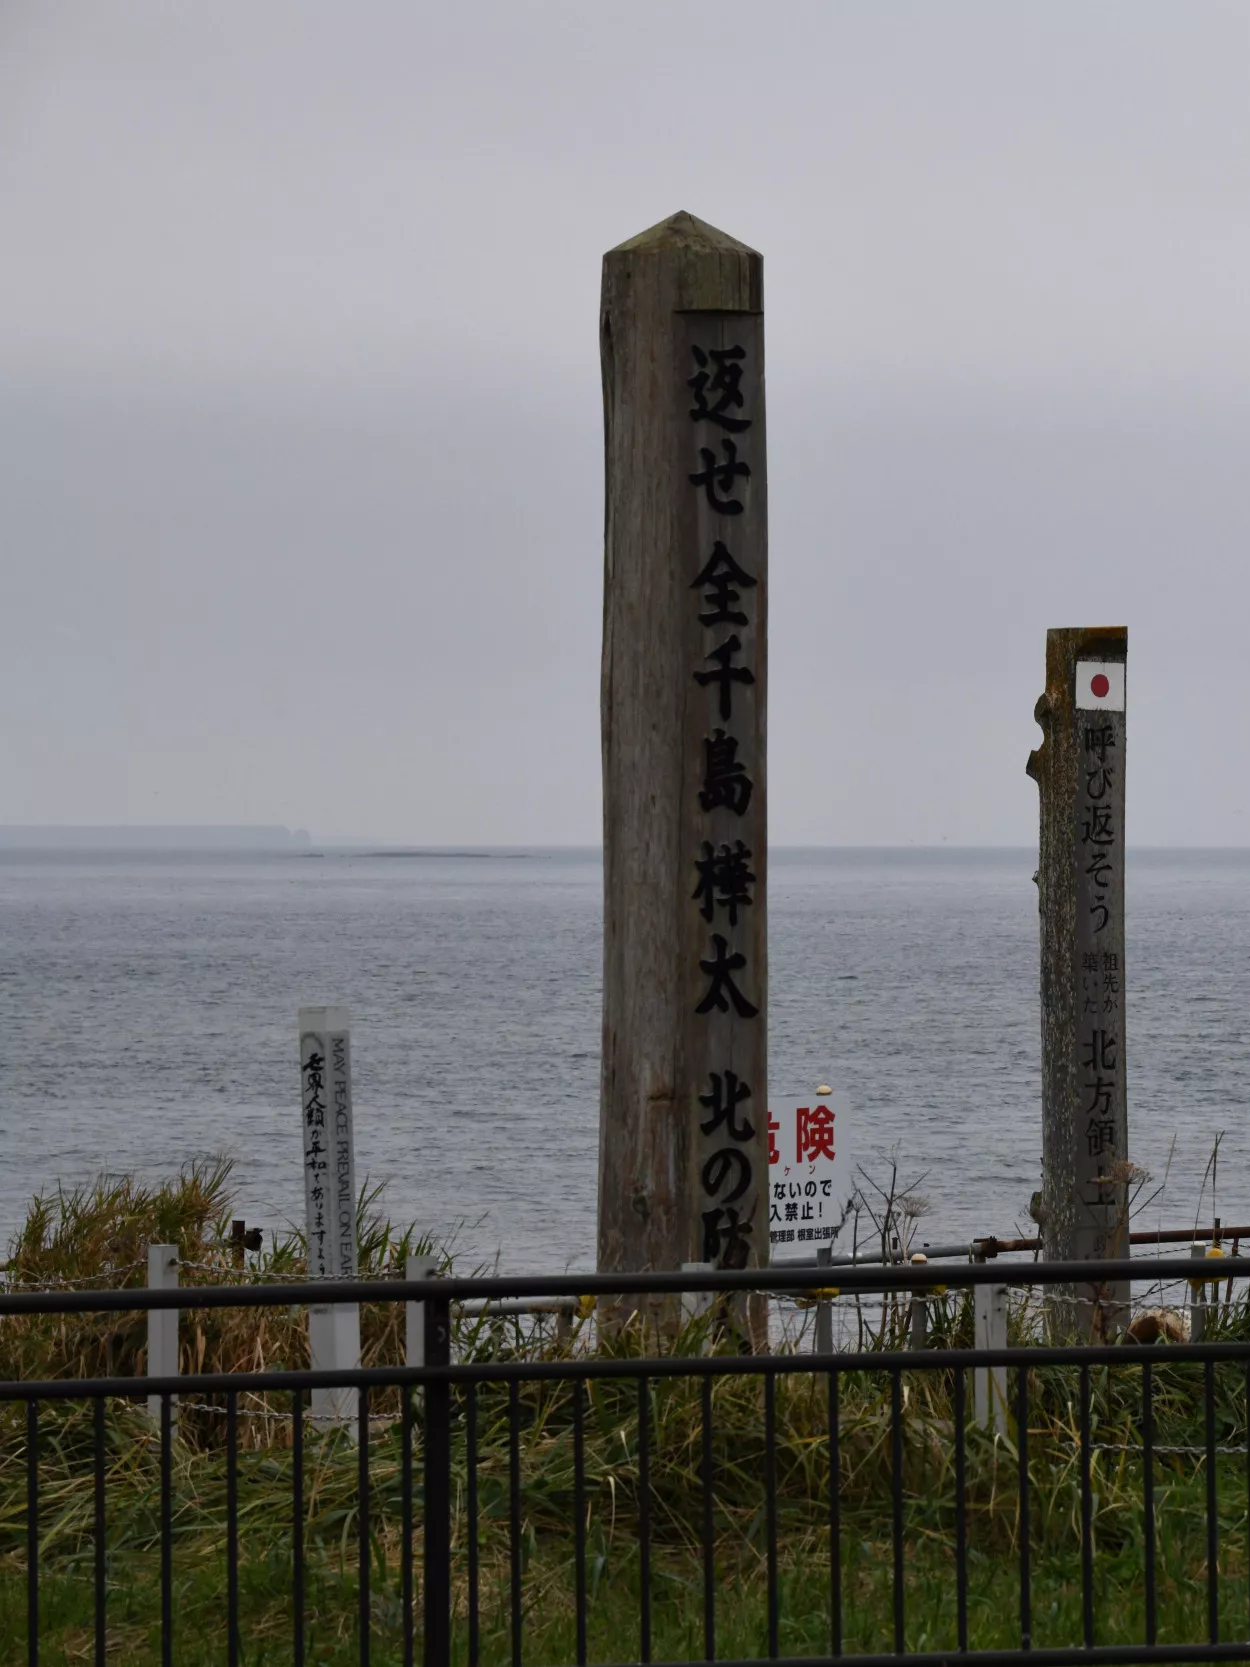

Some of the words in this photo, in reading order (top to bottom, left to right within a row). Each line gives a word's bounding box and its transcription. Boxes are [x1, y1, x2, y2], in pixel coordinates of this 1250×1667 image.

[1081, 725, 1116, 934] 呼び返そう
[1102, 952, 1119, 1014] 祖先が
[332, 1038, 346, 1076] MAY
[334, 1081, 348, 1136] PEACE
[1082, 1029, 1117, 1206] 北方領土
[336, 1141, 351, 1210] PREVAIL
[769, 1179, 832, 1201] ないので
[339, 1210, 352, 1238] ON
[340, 1242, 353, 1276] EAR
